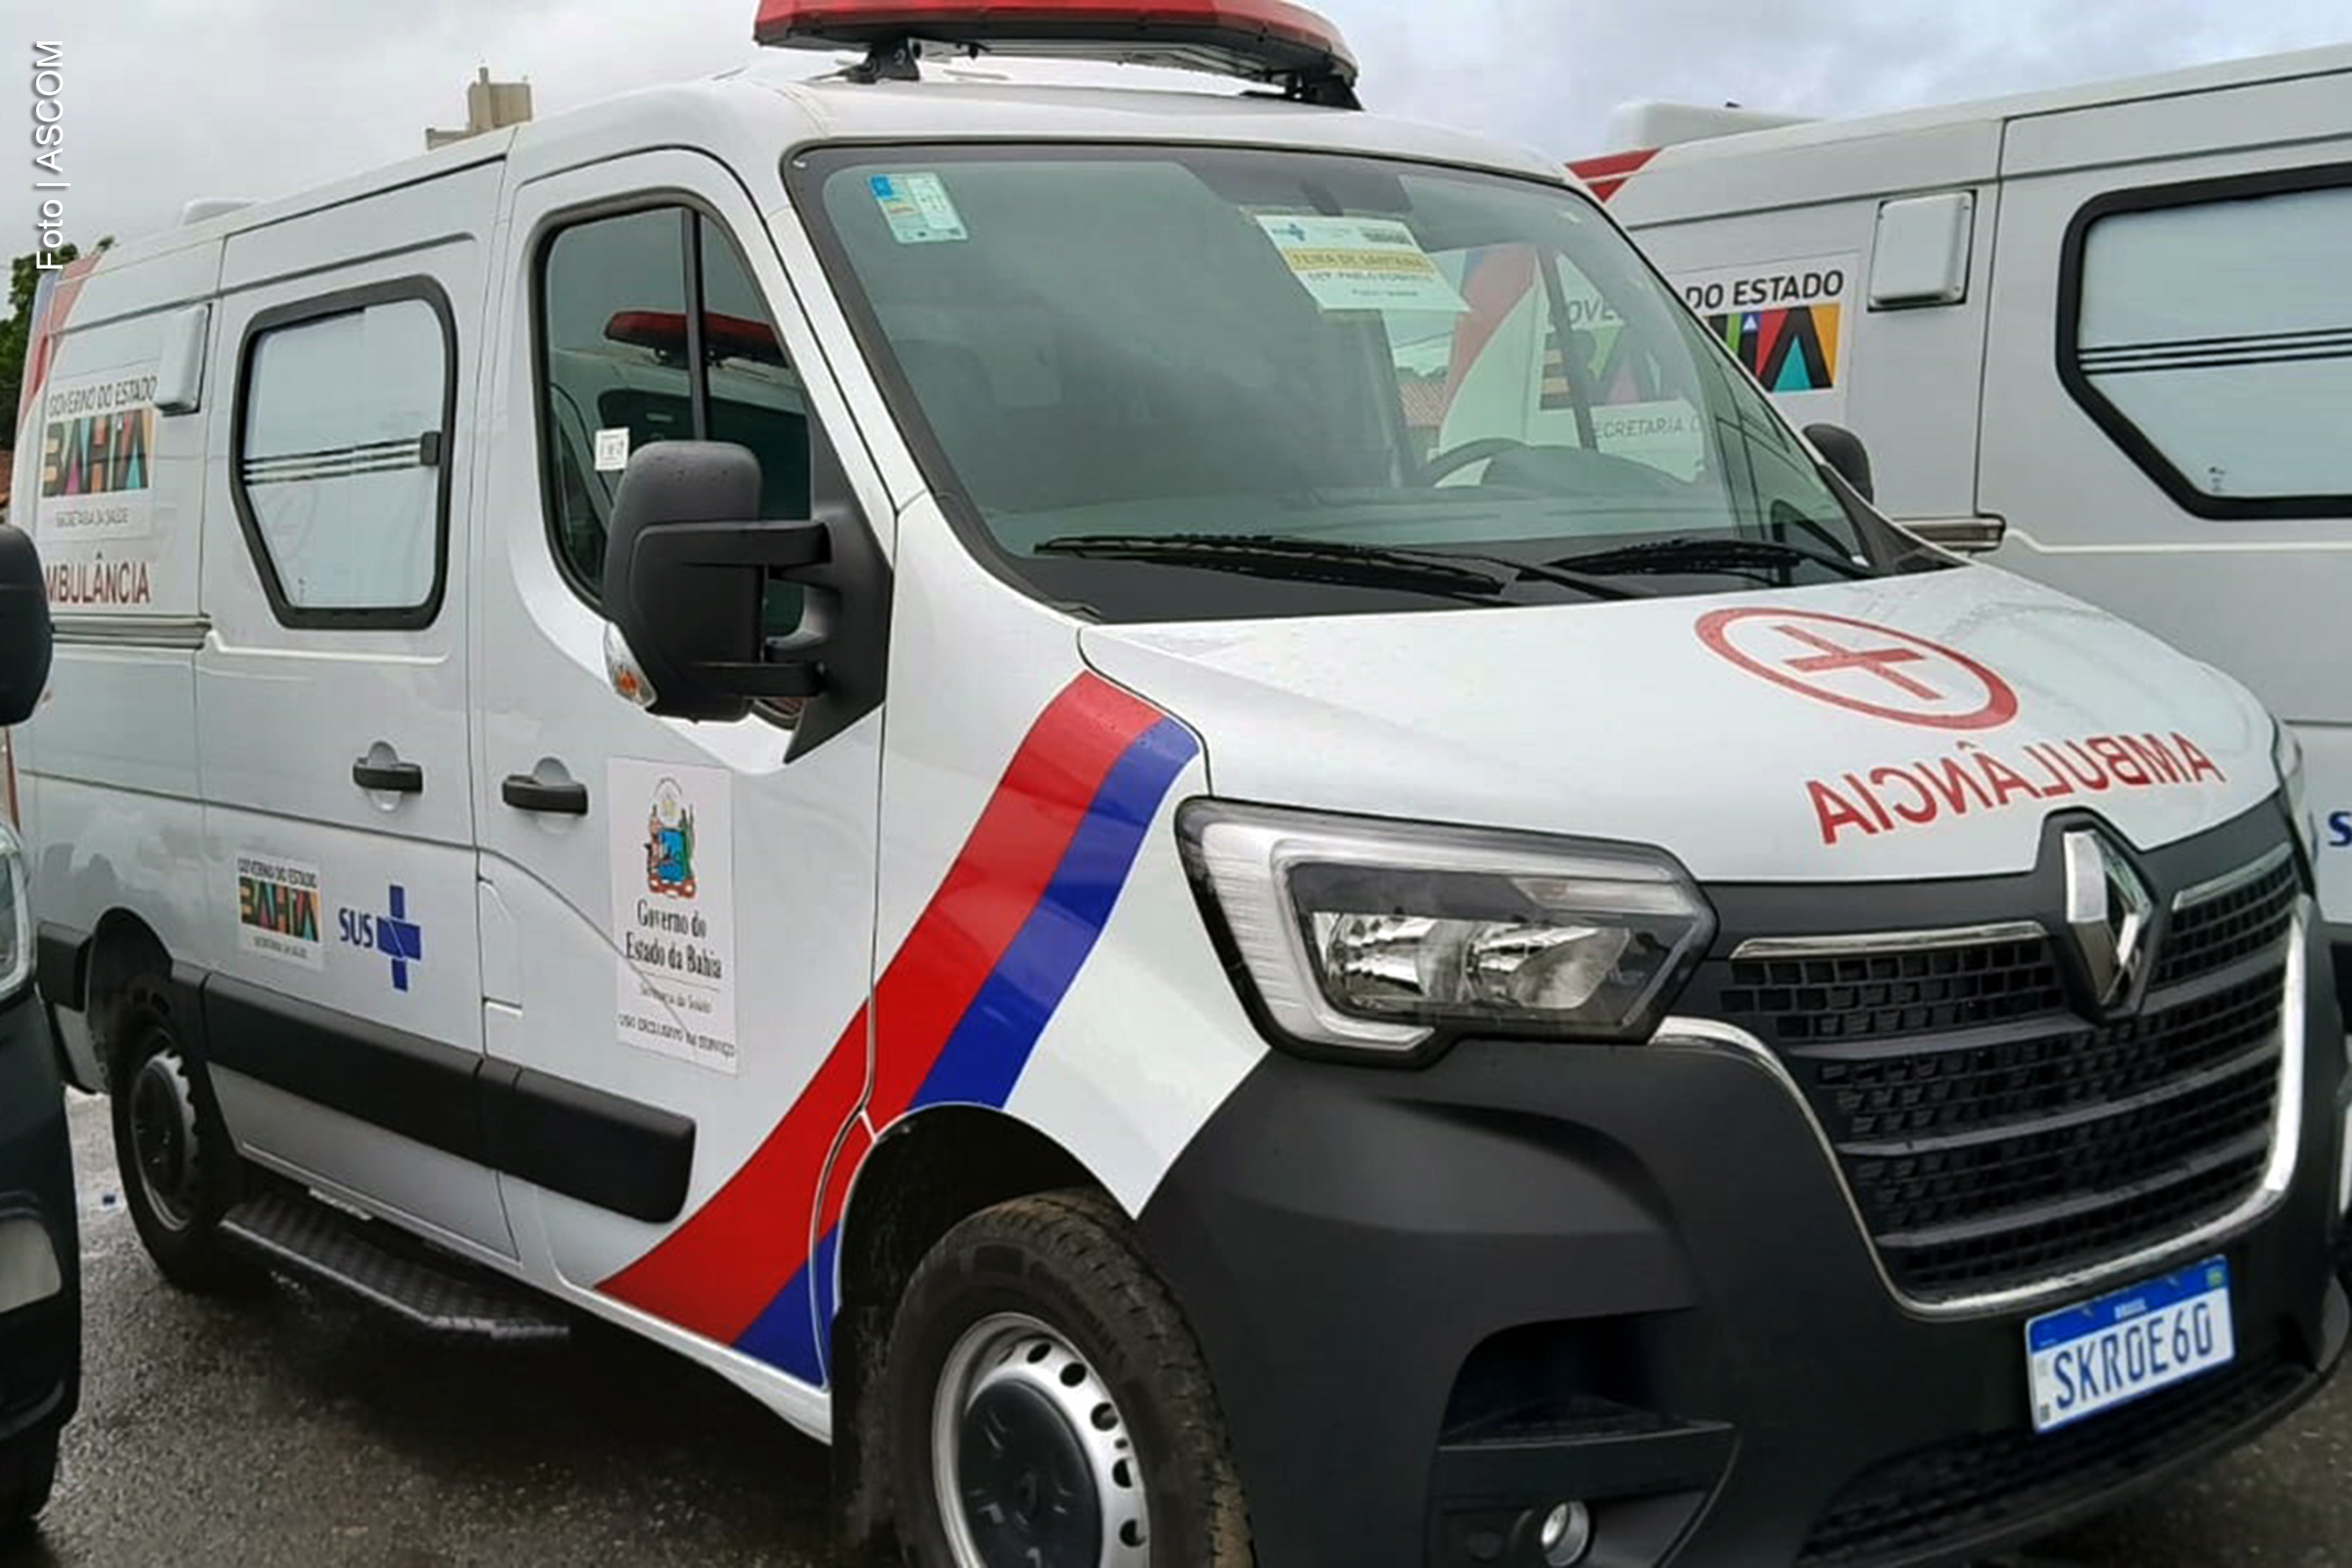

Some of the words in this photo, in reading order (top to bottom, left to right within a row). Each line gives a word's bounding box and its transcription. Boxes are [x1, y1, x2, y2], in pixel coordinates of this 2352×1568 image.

[1686, 283, 1724, 310] DO
[1733, 270, 1844, 306] ESTADO
[115, 374, 158, 406] ESTADO
[42, 408, 151, 498] BAHIA
[45, 551, 150, 604] MBULÂNCIA
[239, 875, 319, 943] BAHIA
[339, 906, 373, 948] SUS
[637, 898, 689, 936] Governo
[691, 908, 707, 939] do
[626, 930, 665, 967] Estado
[667, 941, 683, 970] da
[687, 943, 721, 979] Bahia
